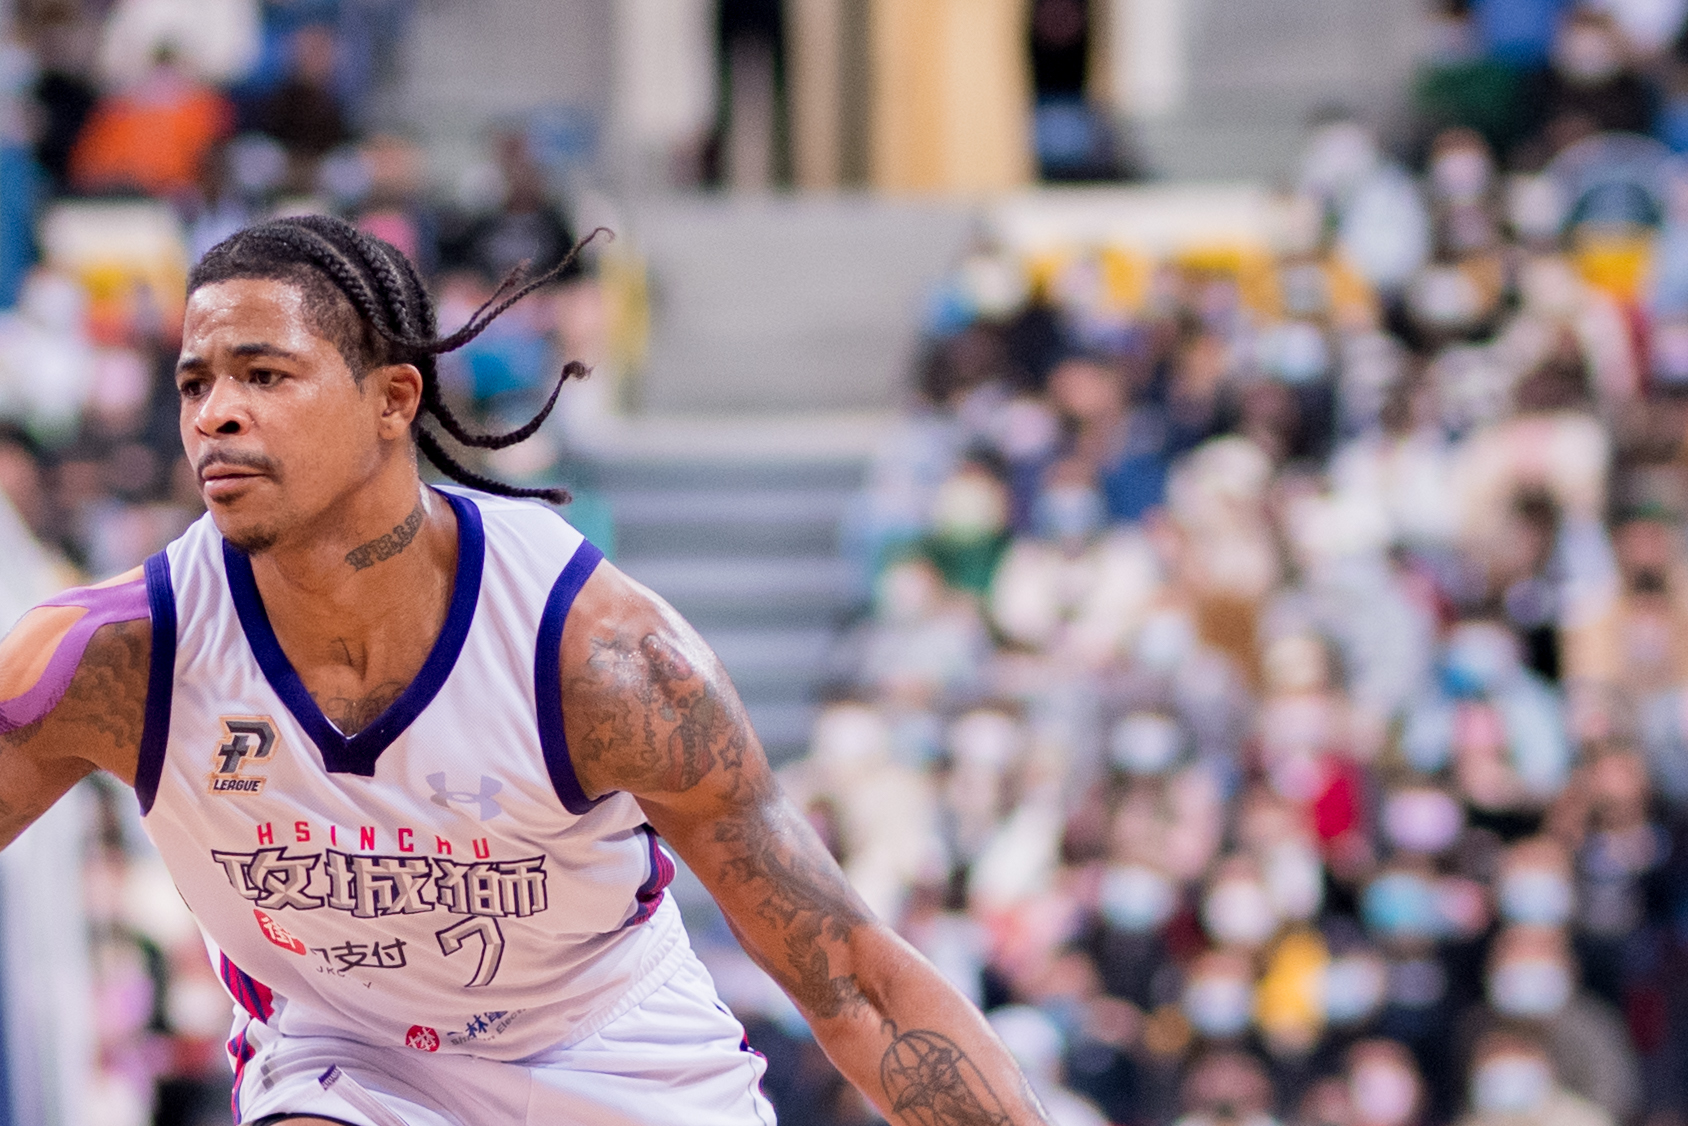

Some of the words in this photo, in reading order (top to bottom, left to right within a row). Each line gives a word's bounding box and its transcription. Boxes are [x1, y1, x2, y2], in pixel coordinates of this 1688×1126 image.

[213, 778, 261, 792] LEAGUE
[256, 821, 491, 860] HSINCHU
[210, 845, 549, 919] 攻城獅
[434, 914, 506, 988] 7
